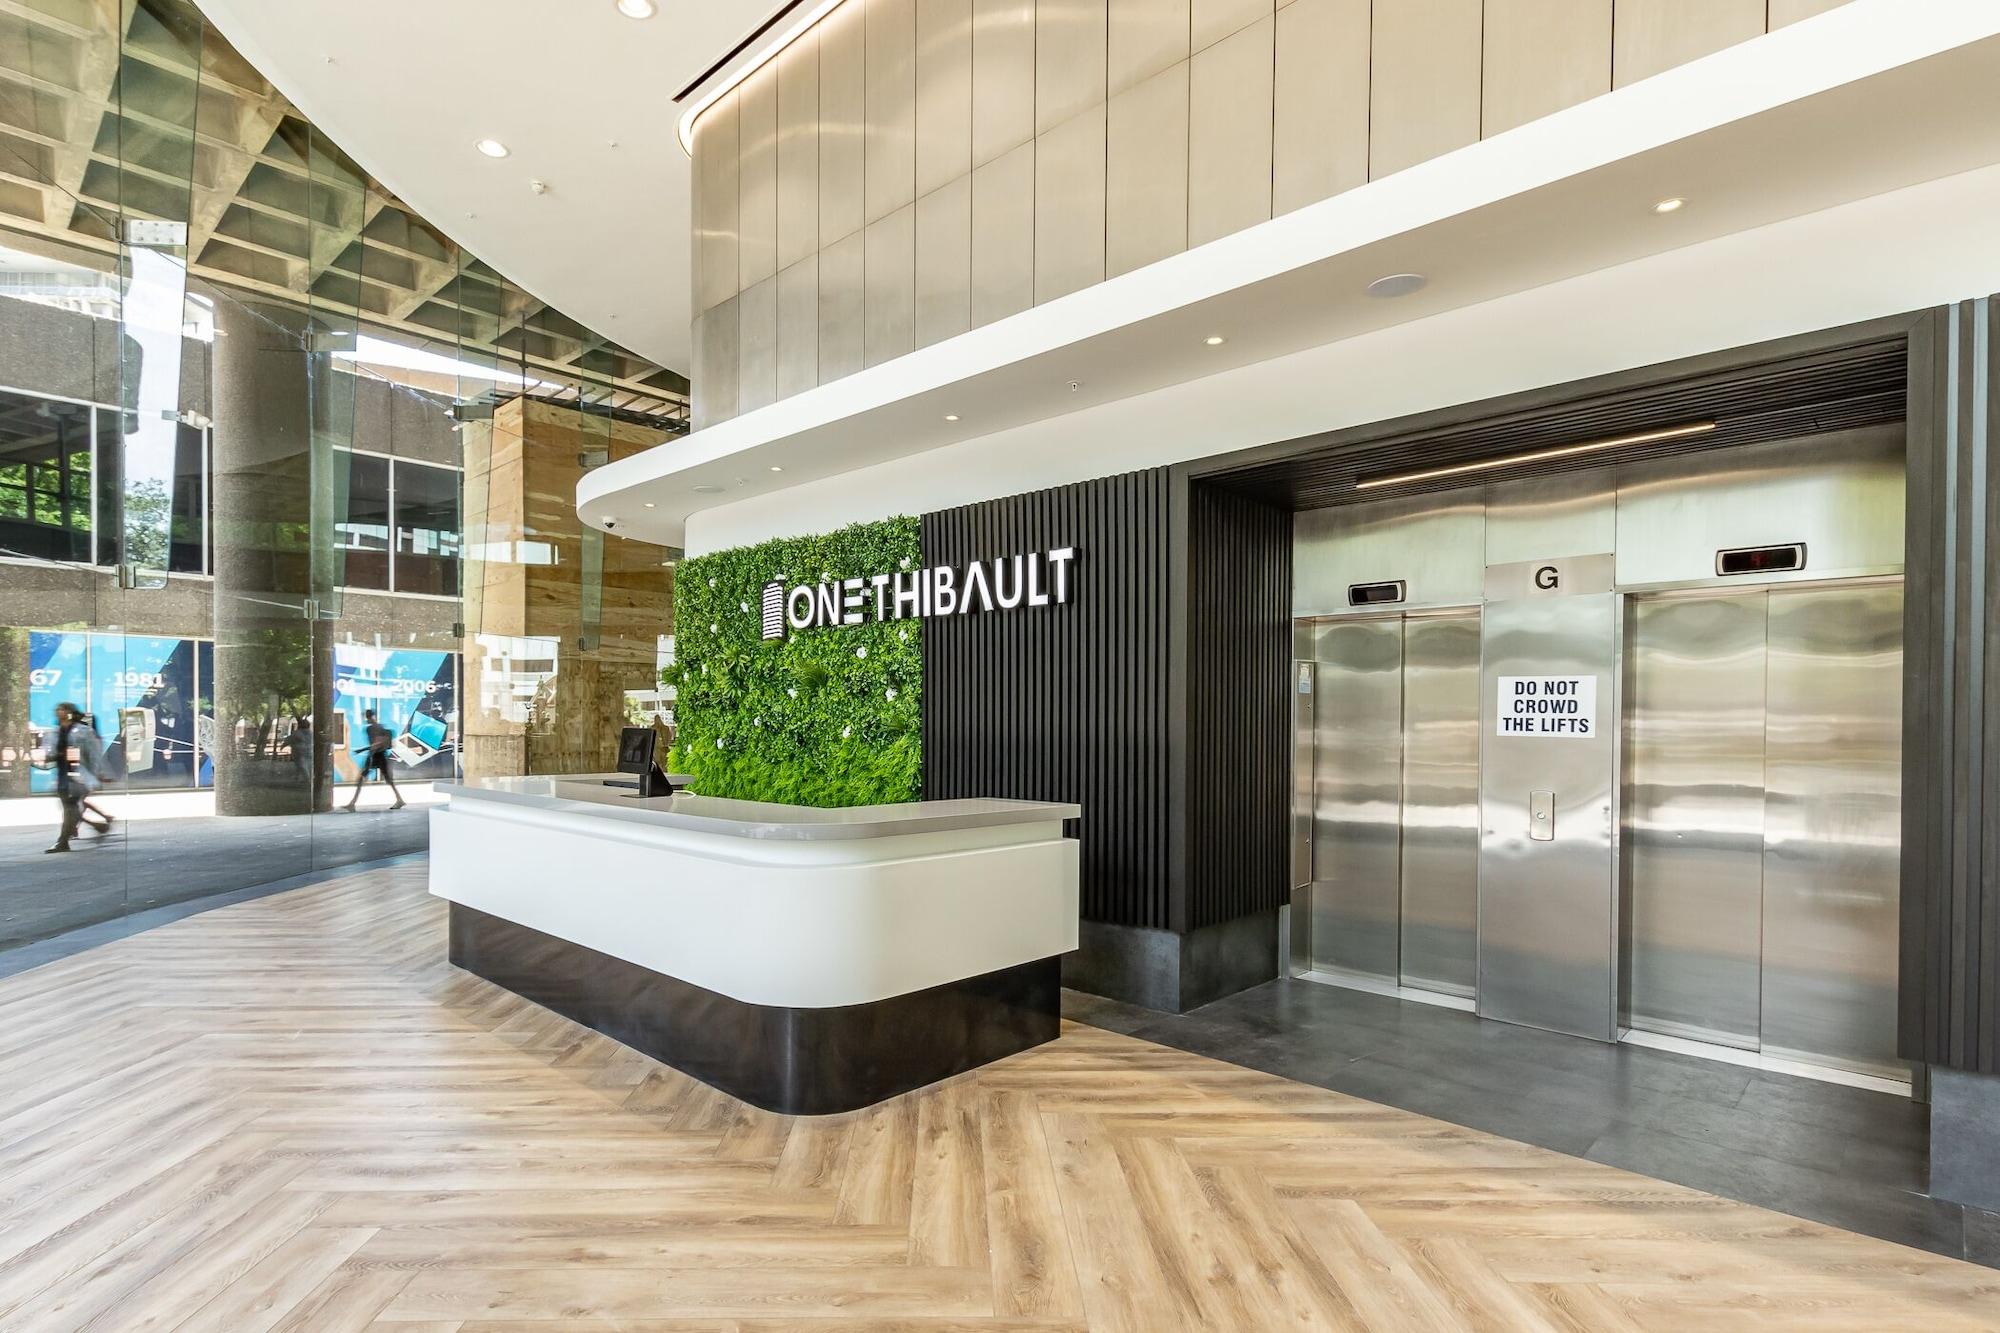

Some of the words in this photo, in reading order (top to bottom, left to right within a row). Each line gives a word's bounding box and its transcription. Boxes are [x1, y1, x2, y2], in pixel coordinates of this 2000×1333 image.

[1535, 566, 1558, 590] G
[30, 669, 62, 686] 67
[114, 671, 165, 688] 1981
[1515, 681, 1537, 695] DO
[1544, 681, 1579, 695] NOT
[1514, 699, 1578, 714] CROWD
[1503, 717, 1534, 732] THE
[1541, 718, 1589, 733] LIFTS
